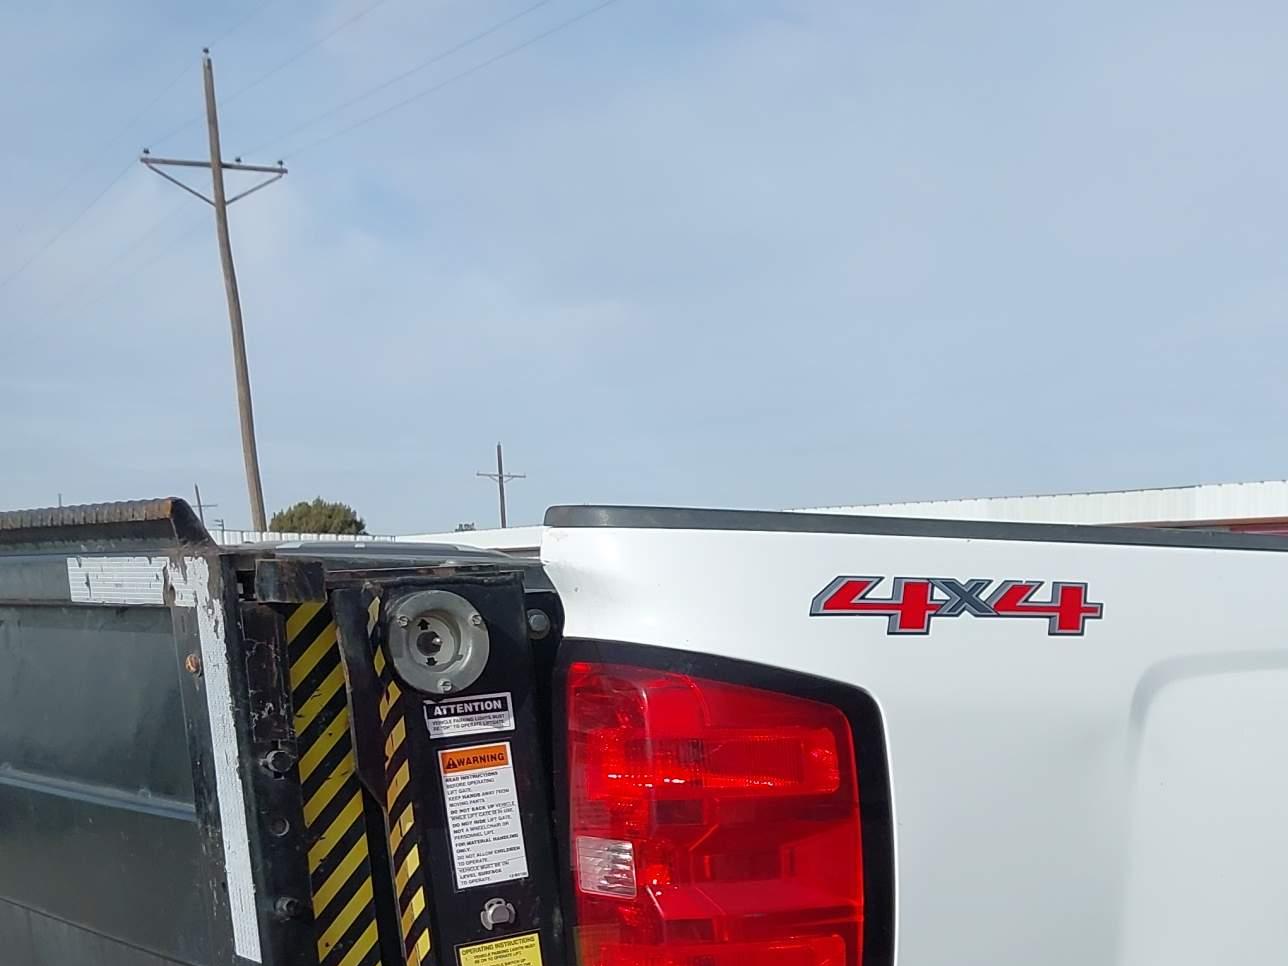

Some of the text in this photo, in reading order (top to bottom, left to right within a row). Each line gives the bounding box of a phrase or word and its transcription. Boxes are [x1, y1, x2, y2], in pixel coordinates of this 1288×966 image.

[433, 700, 502, 716] ATTENTION
[457, 753, 505, 767] WARNING
[462, 936, 535, 956] OPERATING INSTRUCTIONS
